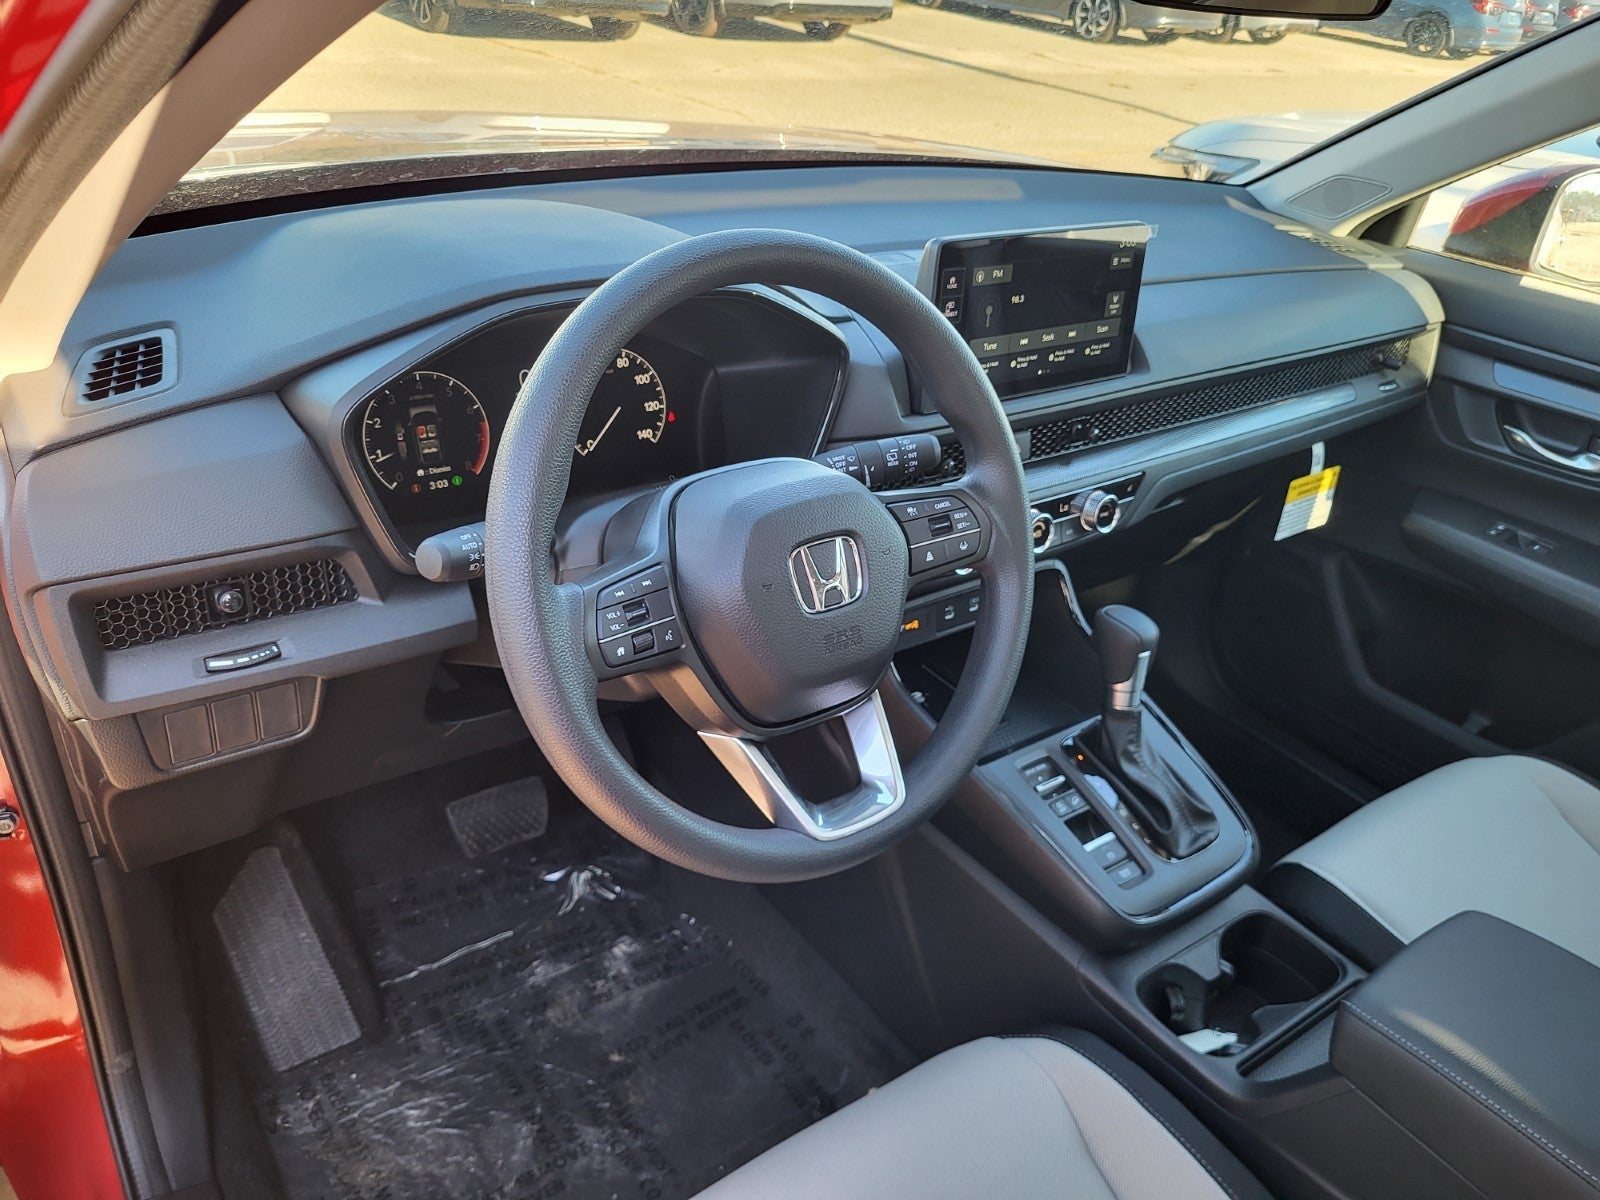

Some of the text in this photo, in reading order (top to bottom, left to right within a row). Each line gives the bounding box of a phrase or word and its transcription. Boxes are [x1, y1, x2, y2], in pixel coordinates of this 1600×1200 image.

[993, 269, 1004, 278] FM
[983, 342, 998, 351] Tune
[616, 357, 629, 368] 80
[634, 373, 650, 384] 100
[446, 387, 453, 397] 5
[388, 394, 396, 405] 3
[643, 400, 660, 412] 120
[373, 418, 382, 429] 2
[637, 428, 653, 440] 140
[905, 443, 917, 451] OFF
[834, 461, 846, 469] OFF
[429, 479, 449, 490] 3:03
[462, 542, 478, 551] AUTO
